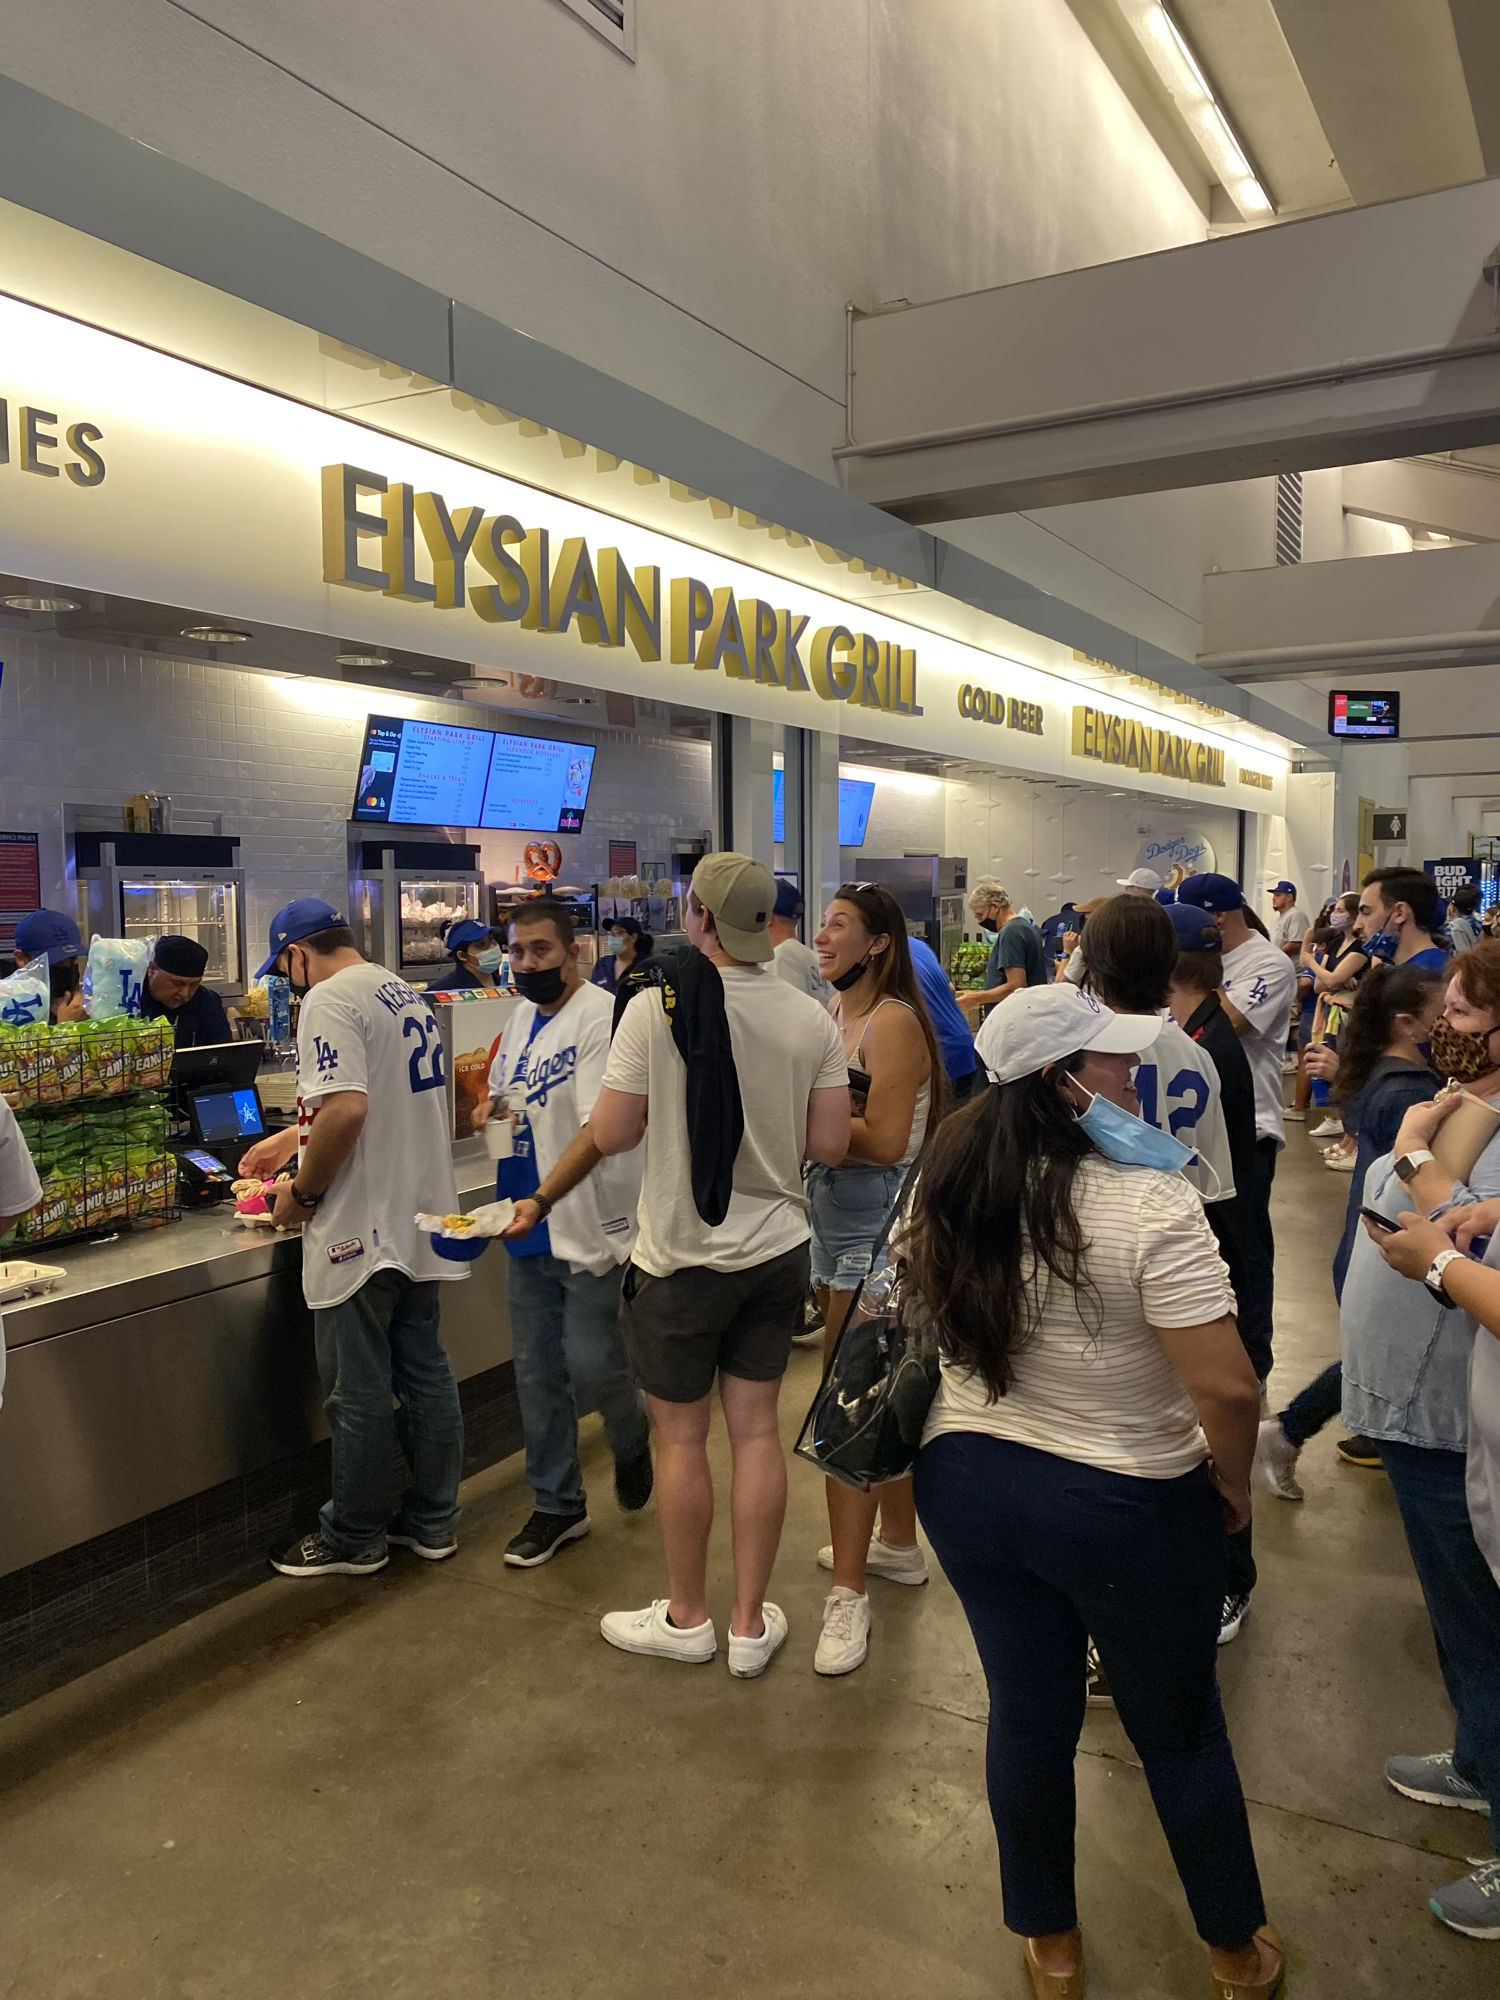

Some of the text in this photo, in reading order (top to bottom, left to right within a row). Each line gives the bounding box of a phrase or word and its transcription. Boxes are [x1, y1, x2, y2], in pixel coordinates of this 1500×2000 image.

[321, 463, 924, 717] ELYSIAN PARK GRILL
[958, 684, 1044, 736] COLD BEER
[412, 725, 486, 742] ELYSIAN PARK GRILL
[502, 738, 565, 752] ELYSIAN PARK GRILL
[1072, 706, 1226, 787] ELYSIAN PARK GRILL
[1147, 836, 1207, 862] Dodger Dogs
[1434, 866, 1467, 876] BUD
[1435, 876, 1473, 887] IGHT
[119, 969, 142, 1019] LA
[375, 981, 428, 1016] KERSH
[1249, 977, 1268, 1003] LA
[313, 1035, 338, 1072] LA
[403, 1014, 446, 1094] 22
[458, 1062, 486, 1073] ICE COLD
[525, 1045, 577, 1107] dgers
